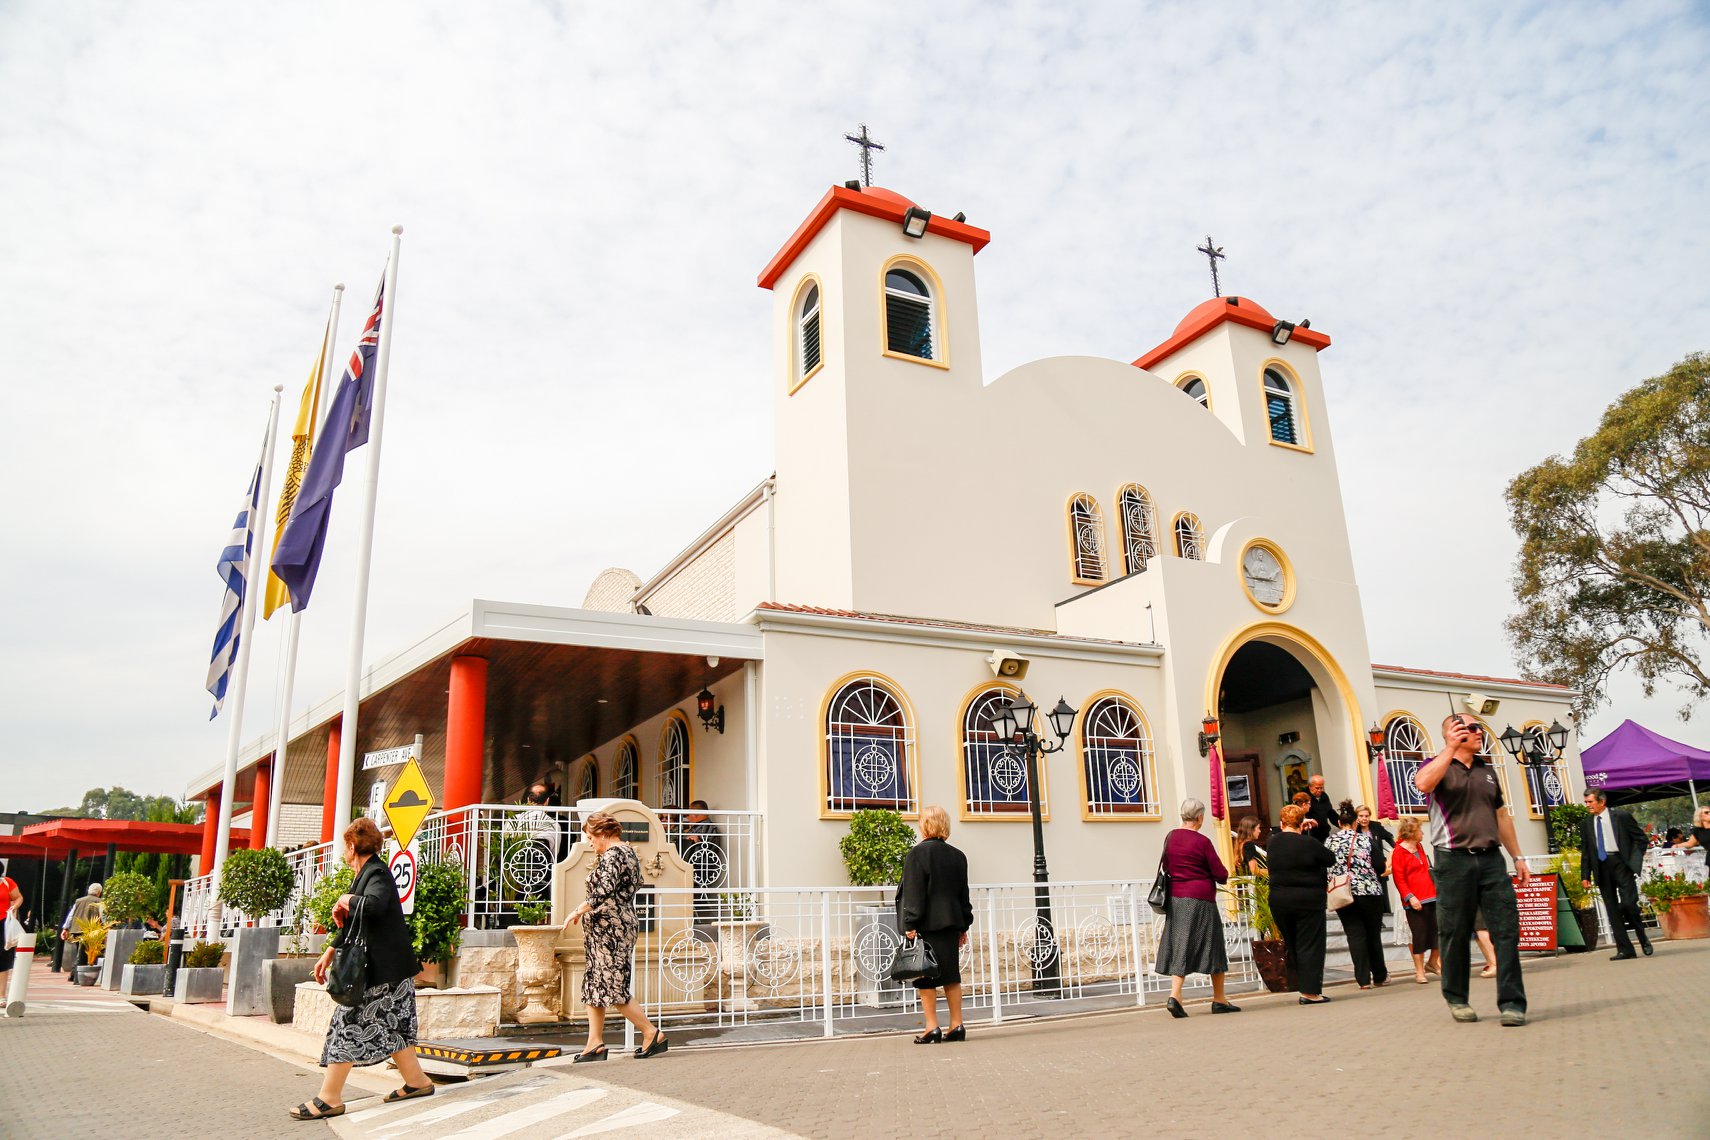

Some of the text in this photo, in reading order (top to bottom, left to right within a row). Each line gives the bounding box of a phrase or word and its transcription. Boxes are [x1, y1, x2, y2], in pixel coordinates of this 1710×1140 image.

[371, 748, 411, 766] CARPENTER AVE
[394, 863, 411, 888] 25
